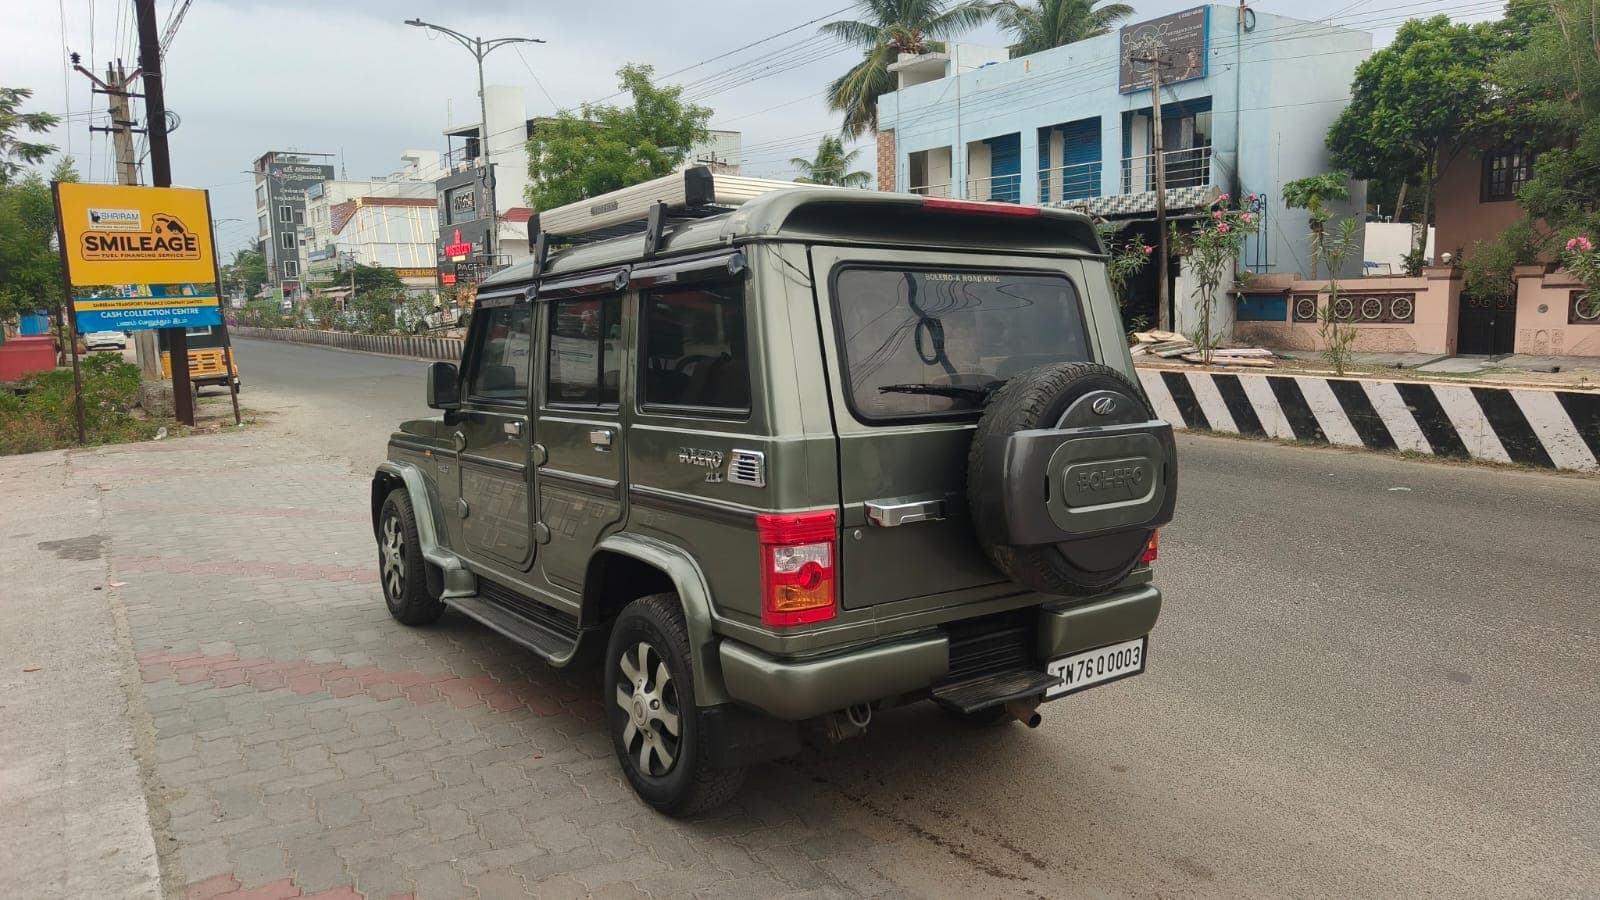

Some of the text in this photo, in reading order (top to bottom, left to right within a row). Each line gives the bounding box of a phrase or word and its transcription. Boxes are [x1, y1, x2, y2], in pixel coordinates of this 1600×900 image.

[100, 212, 138, 220] SHRIRAM
[84, 235, 196, 252] SMILEAGE
[123, 309, 170, 317] COLLECTION
[172, 307, 199, 315] CENTRE
[679, 447, 724, 470] BOLERO
[1077, 465, 1143, 496] BOLERO
